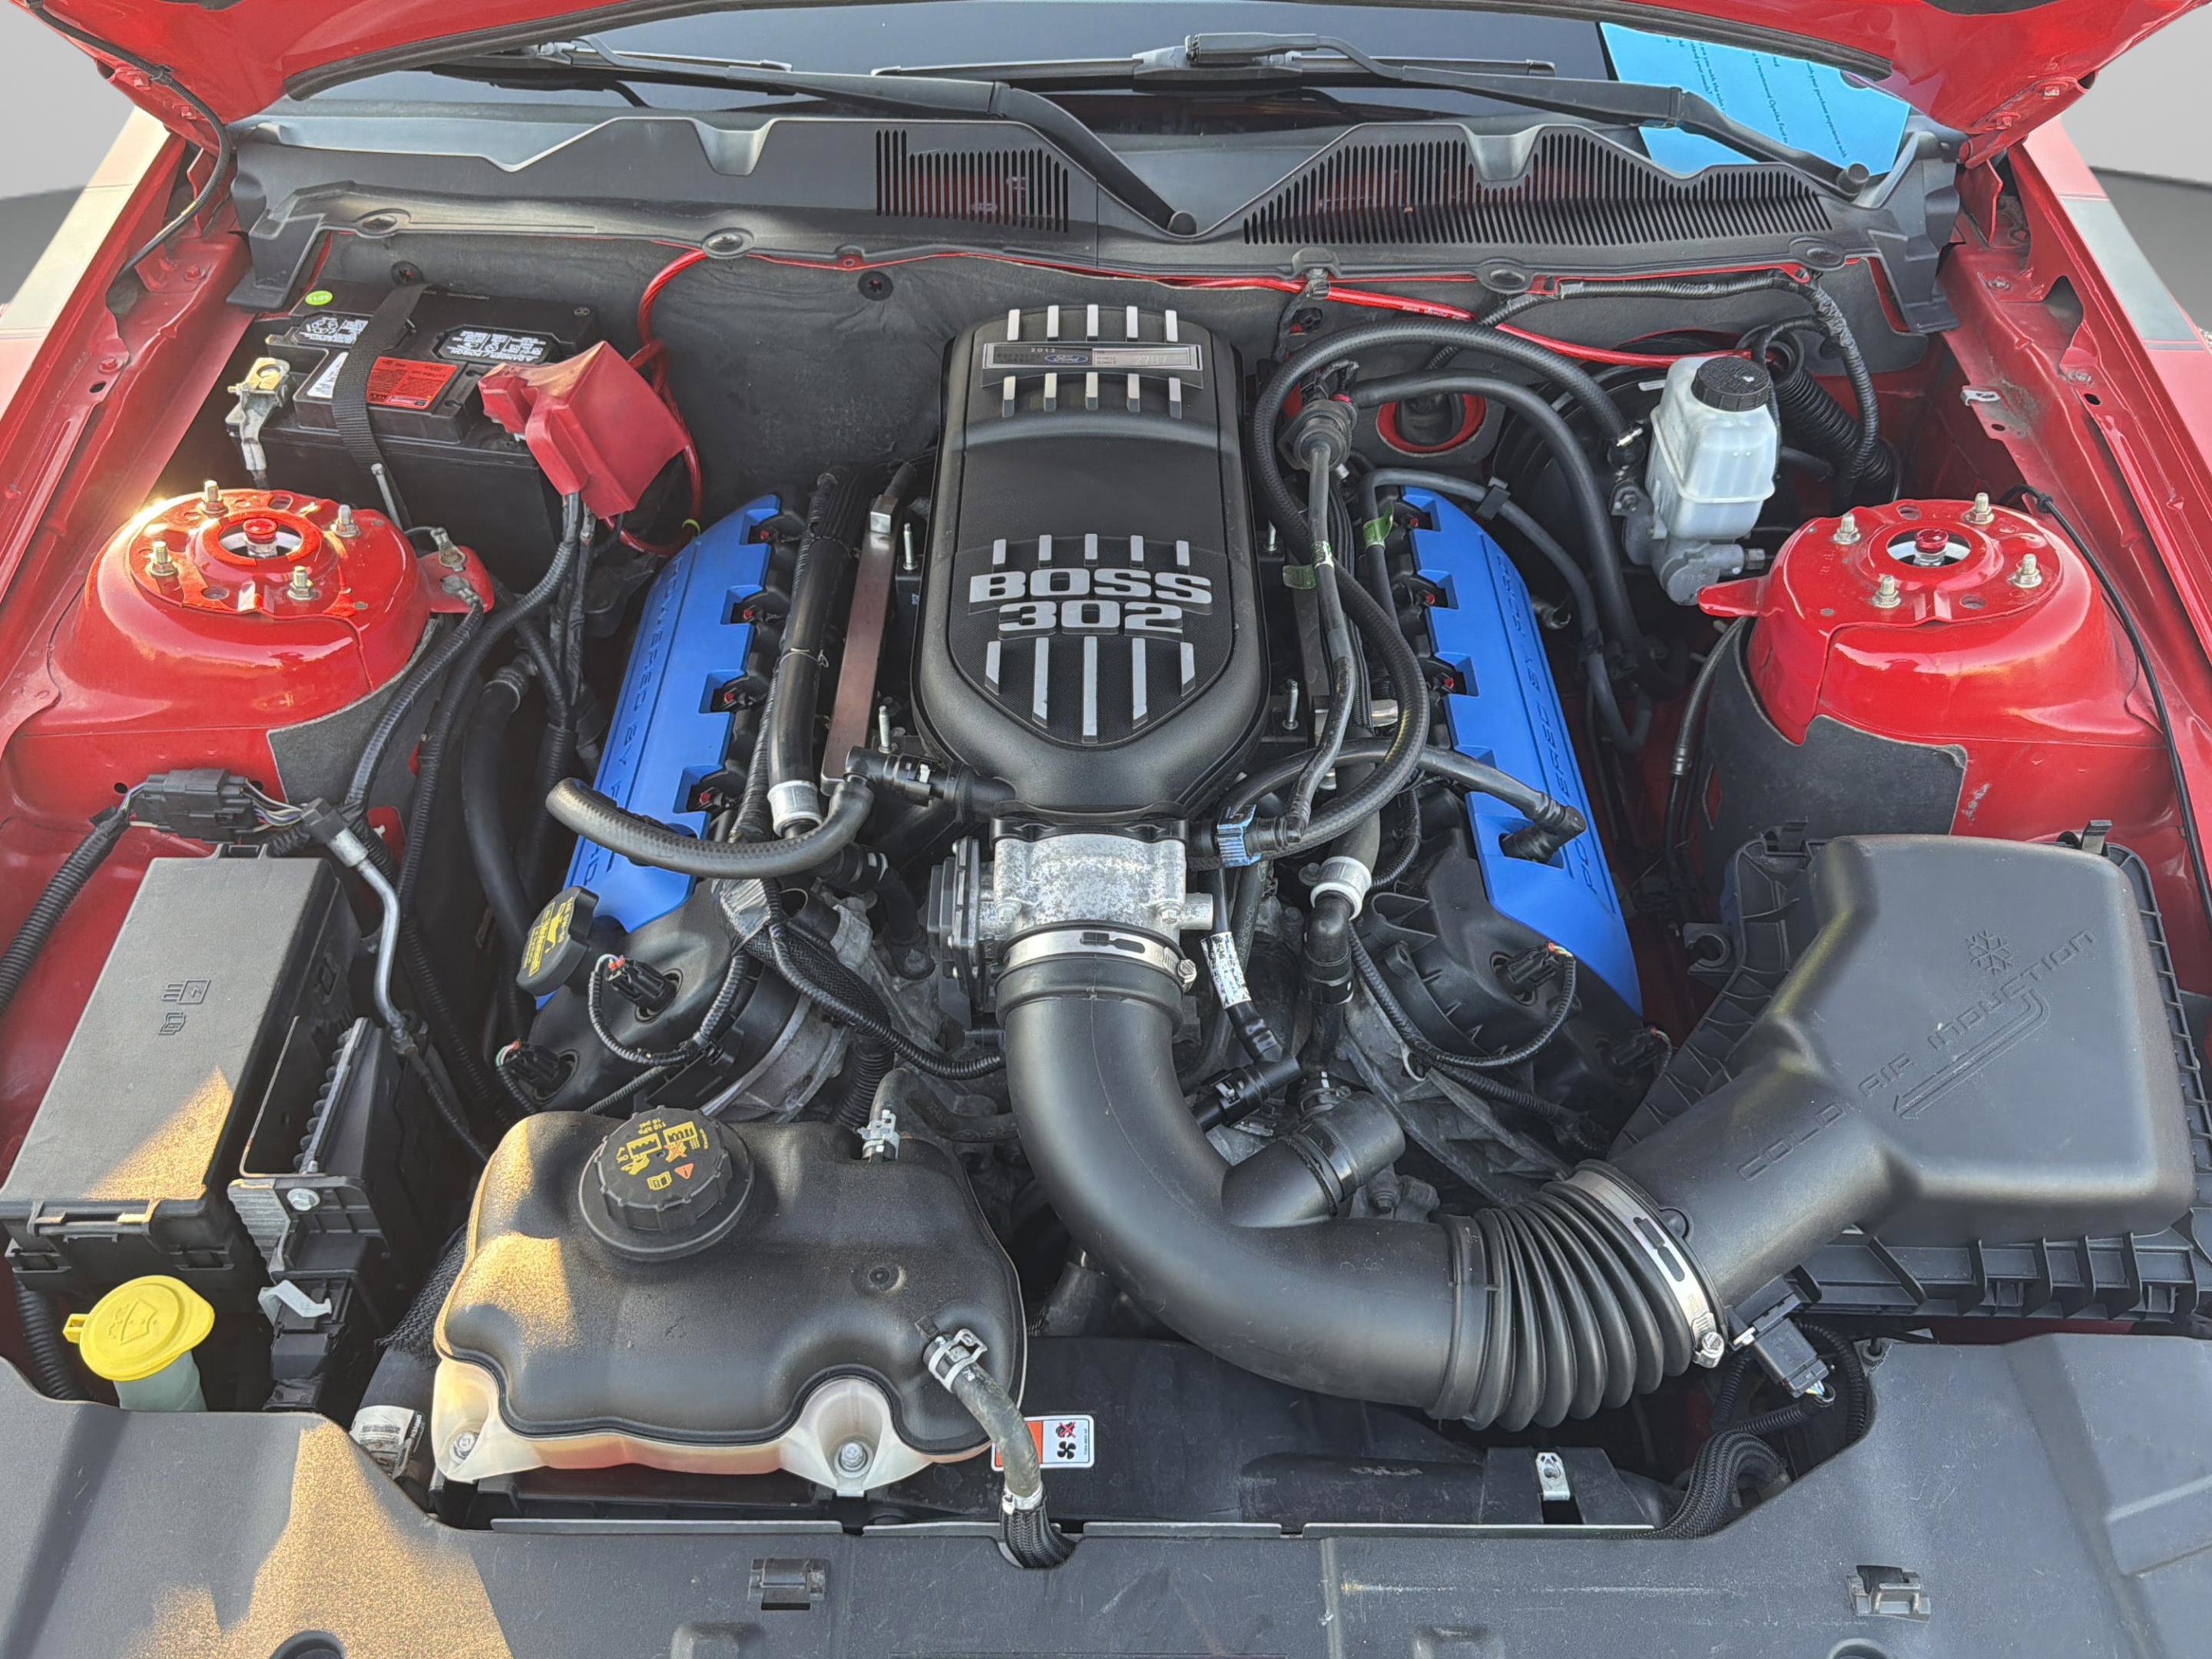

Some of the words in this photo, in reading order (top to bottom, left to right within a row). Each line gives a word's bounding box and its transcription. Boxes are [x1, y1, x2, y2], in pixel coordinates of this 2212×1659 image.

[1757, 64, 1772, 98] recommend
[1778, 122, 1787, 136] Ford
[1809, 75, 1817, 88] your
[1814, 88, 1829, 114] purchase
[1048, 355, 1084, 363] Ford
[969, 567, 1213, 611] BOSS
[998, 600, 1184, 640] 302
[1536, 700, 1598, 895] POERED
[617, 1154, 628, 1163] OK
